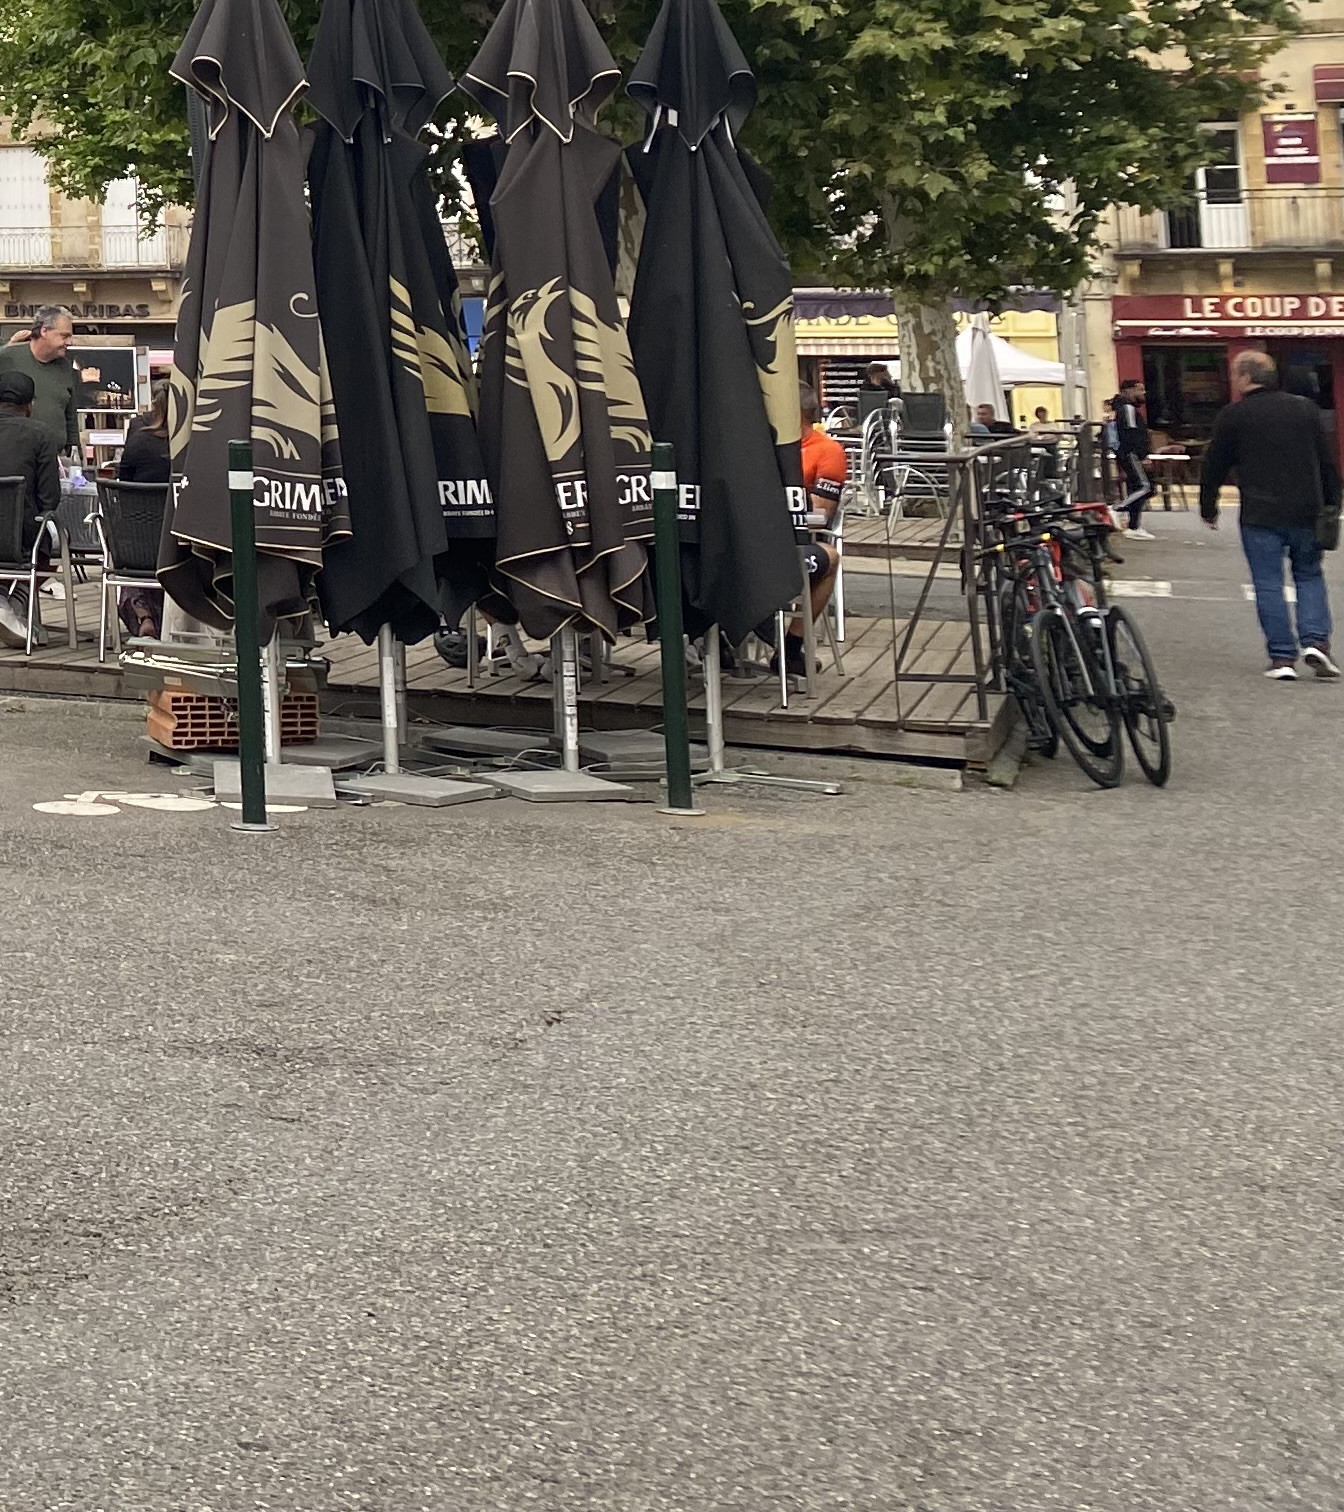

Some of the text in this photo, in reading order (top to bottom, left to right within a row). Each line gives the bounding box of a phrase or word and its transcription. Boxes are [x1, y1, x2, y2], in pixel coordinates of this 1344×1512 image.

[1184, 298, 1222, 318] LE
[1225, 297, 1301, 318] COUP
[616, 474, 653, 505] GR
